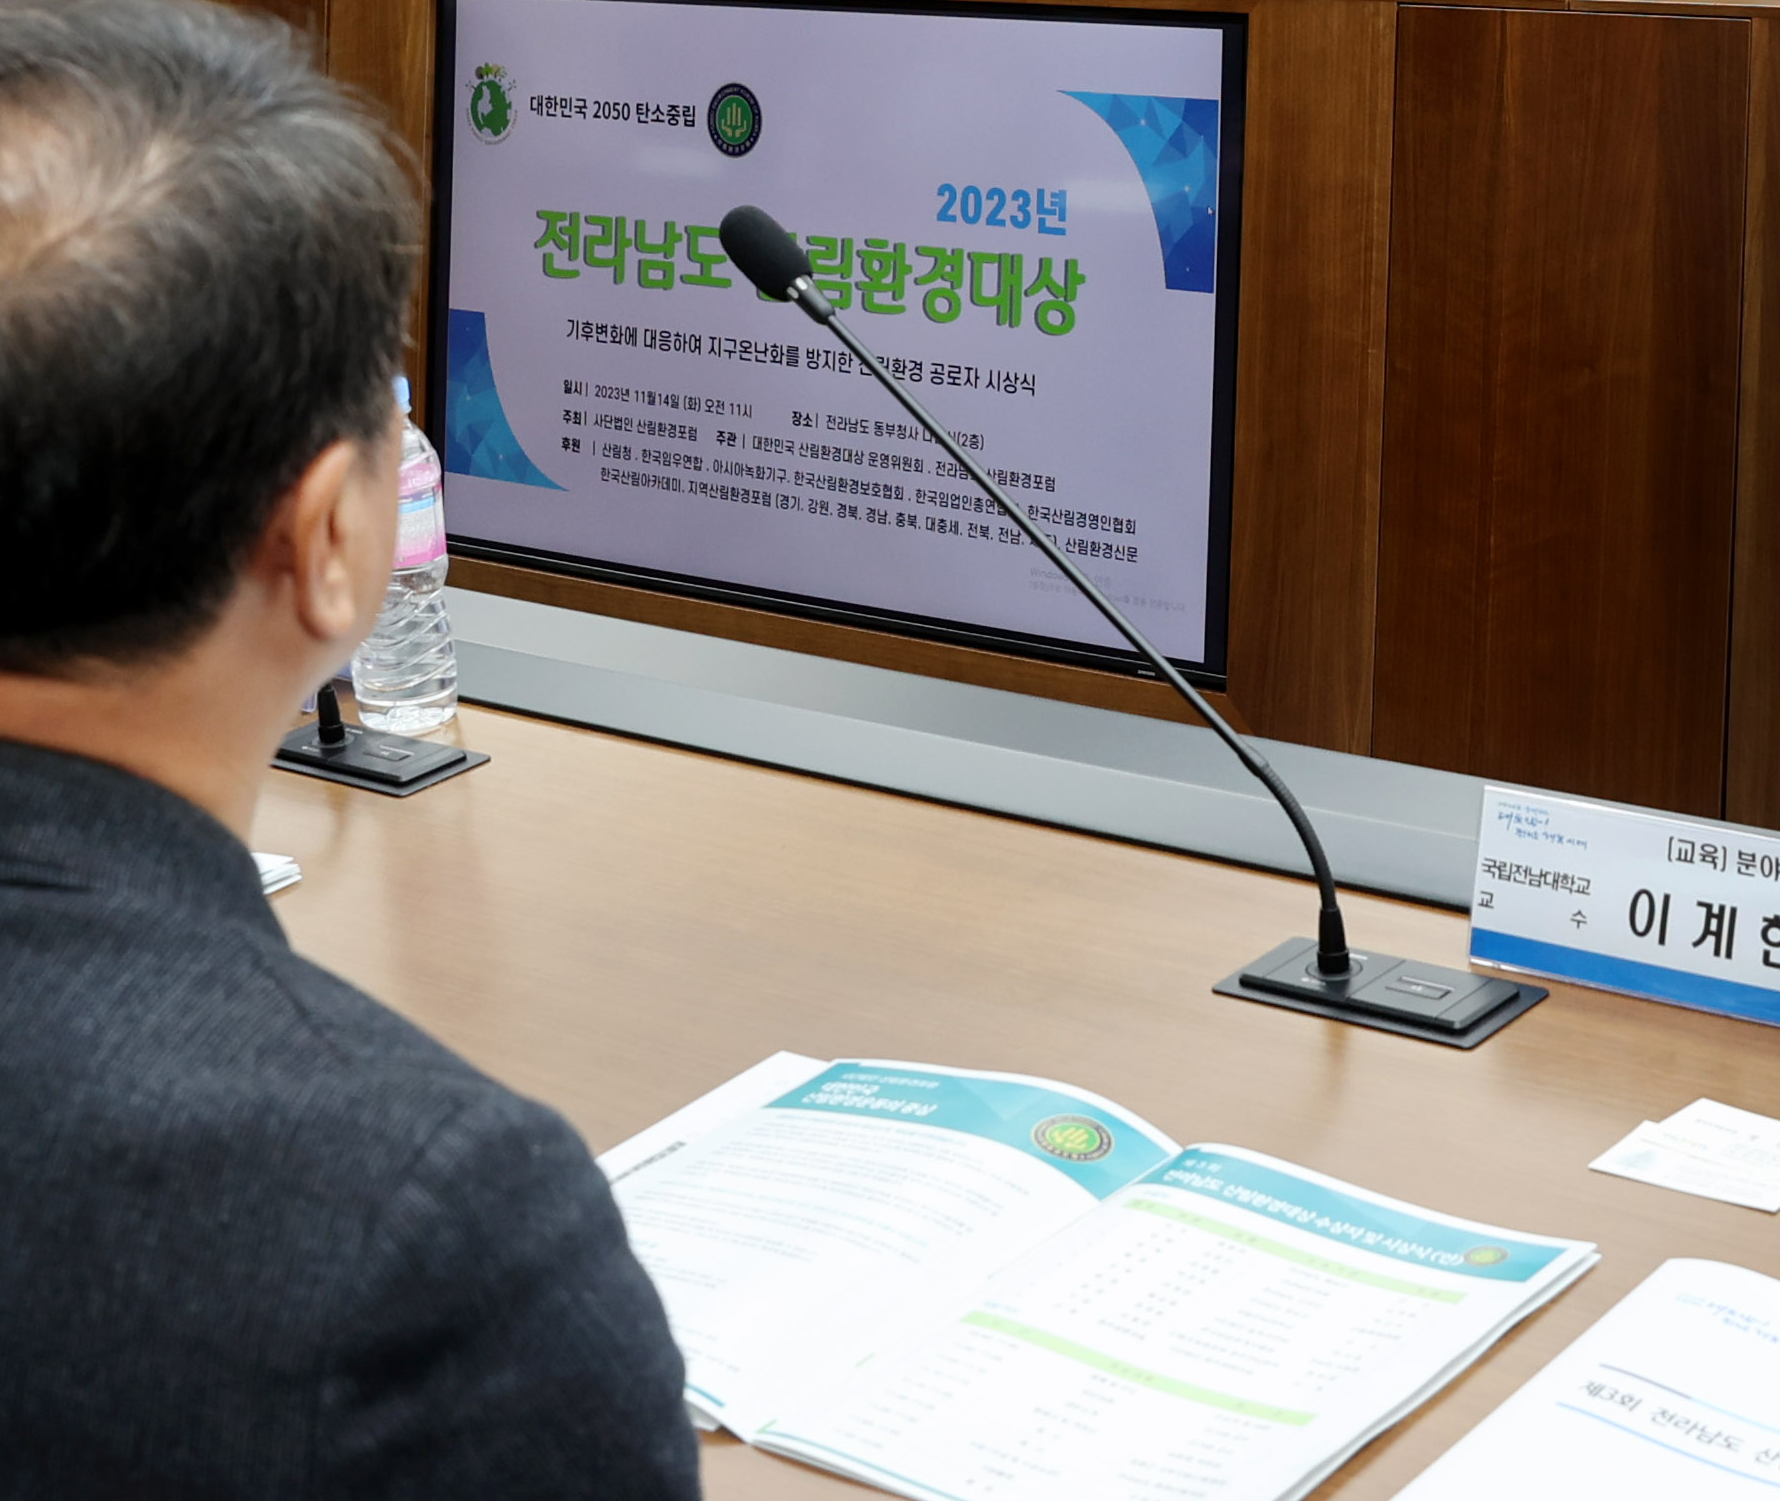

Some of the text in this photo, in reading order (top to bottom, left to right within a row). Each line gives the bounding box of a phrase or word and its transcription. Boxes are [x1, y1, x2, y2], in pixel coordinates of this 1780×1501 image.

[529, 93, 696, 128] 대한민국 2050 탄소중립
[936, 179, 1068, 237] 2023년
[533, 207, 732, 300] 전라남도
[566, 318, 1035, 397] 기후변화에 대응하여 지구온난화를 방지한 공로자 시상식
[594, 383, 630, 403] 2023년
[634, 388, 680, 409] 11월14일
[683, 394, 701, 413] (화)
[704, 398, 724, 416] 오전
[728, 401, 752, 419] 11시
[593, 412, 633, 433] 사단법인
[636, 418, 697, 442] 산림환경포럼
[825, 414, 869, 435] 전라남도
[873, 420, 919, 442] 동부청사
[752, 434, 795, 456] 대한민국
[798, 441, 864, 466] 산림환경대상
[688, 480, 771, 507] 지역산림환경포럼
[1064, 536, 1138, 564] 산림환경신문
[1481, 857, 1593, 896] 국립전남대학교
[1579, 1380, 1644, 1412] 제3회
[1650, 1406, 1744, 1452] 전라남도
